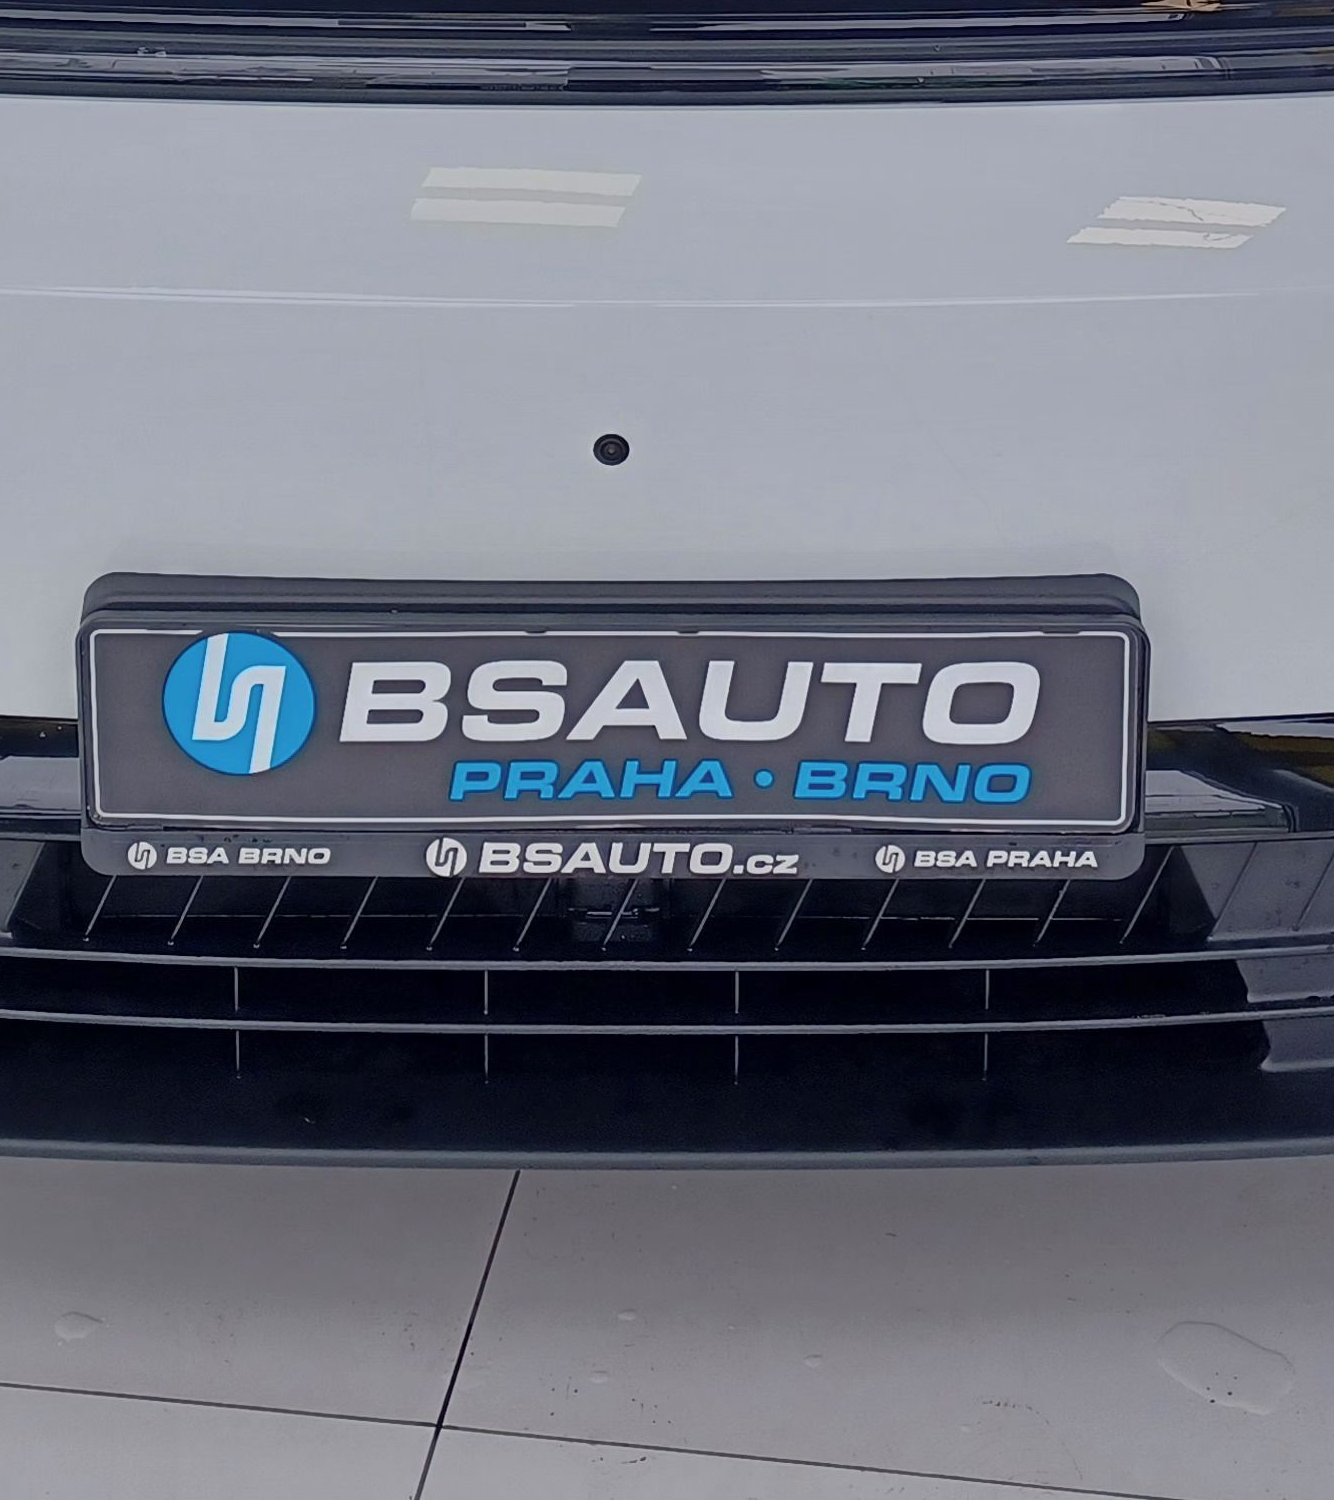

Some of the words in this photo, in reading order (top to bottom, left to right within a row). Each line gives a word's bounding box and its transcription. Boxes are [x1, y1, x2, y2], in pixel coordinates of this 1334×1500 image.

[339, 660, 1041, 745] BSAUTO
[448, 758, 734, 803] PRAHA
[794, 759, 1034, 805] BRNO
[166, 846, 230, 864] BSA
[238, 847, 331, 865] BRNO
[478, 841, 800, 876] BSAUTO.cz
[913, 850, 978, 868] BSA
[986, 850, 1098, 868] PRAHA
